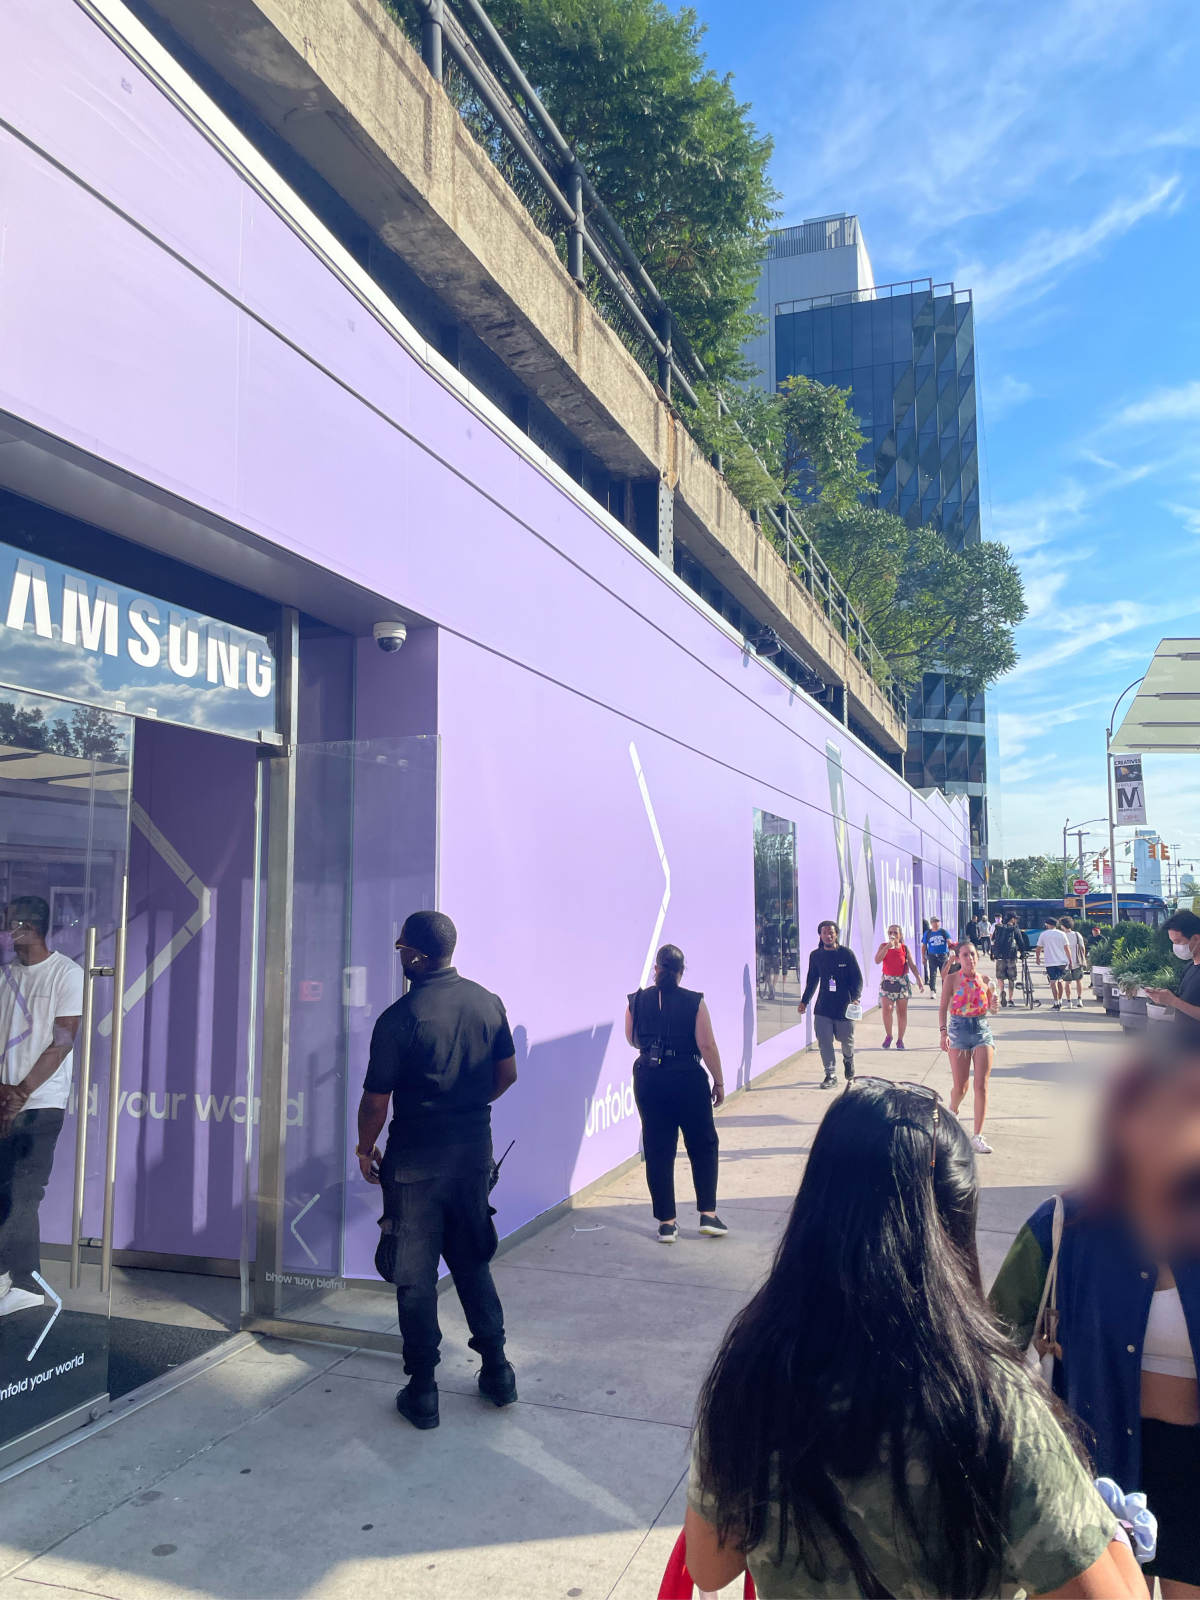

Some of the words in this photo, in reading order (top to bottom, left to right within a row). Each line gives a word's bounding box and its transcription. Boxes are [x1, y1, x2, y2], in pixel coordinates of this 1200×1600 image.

[5, 558, 272, 698] AMSUNG
[117, 1090, 186, 1120] your
[194, 1092, 304, 1127] word
[585, 1076, 634, 1137] Unfold
[0, 1377, 28, 1401] nfold
[30, 1368, 54, 1391] your
[55, 1352, 85, 1376] world
